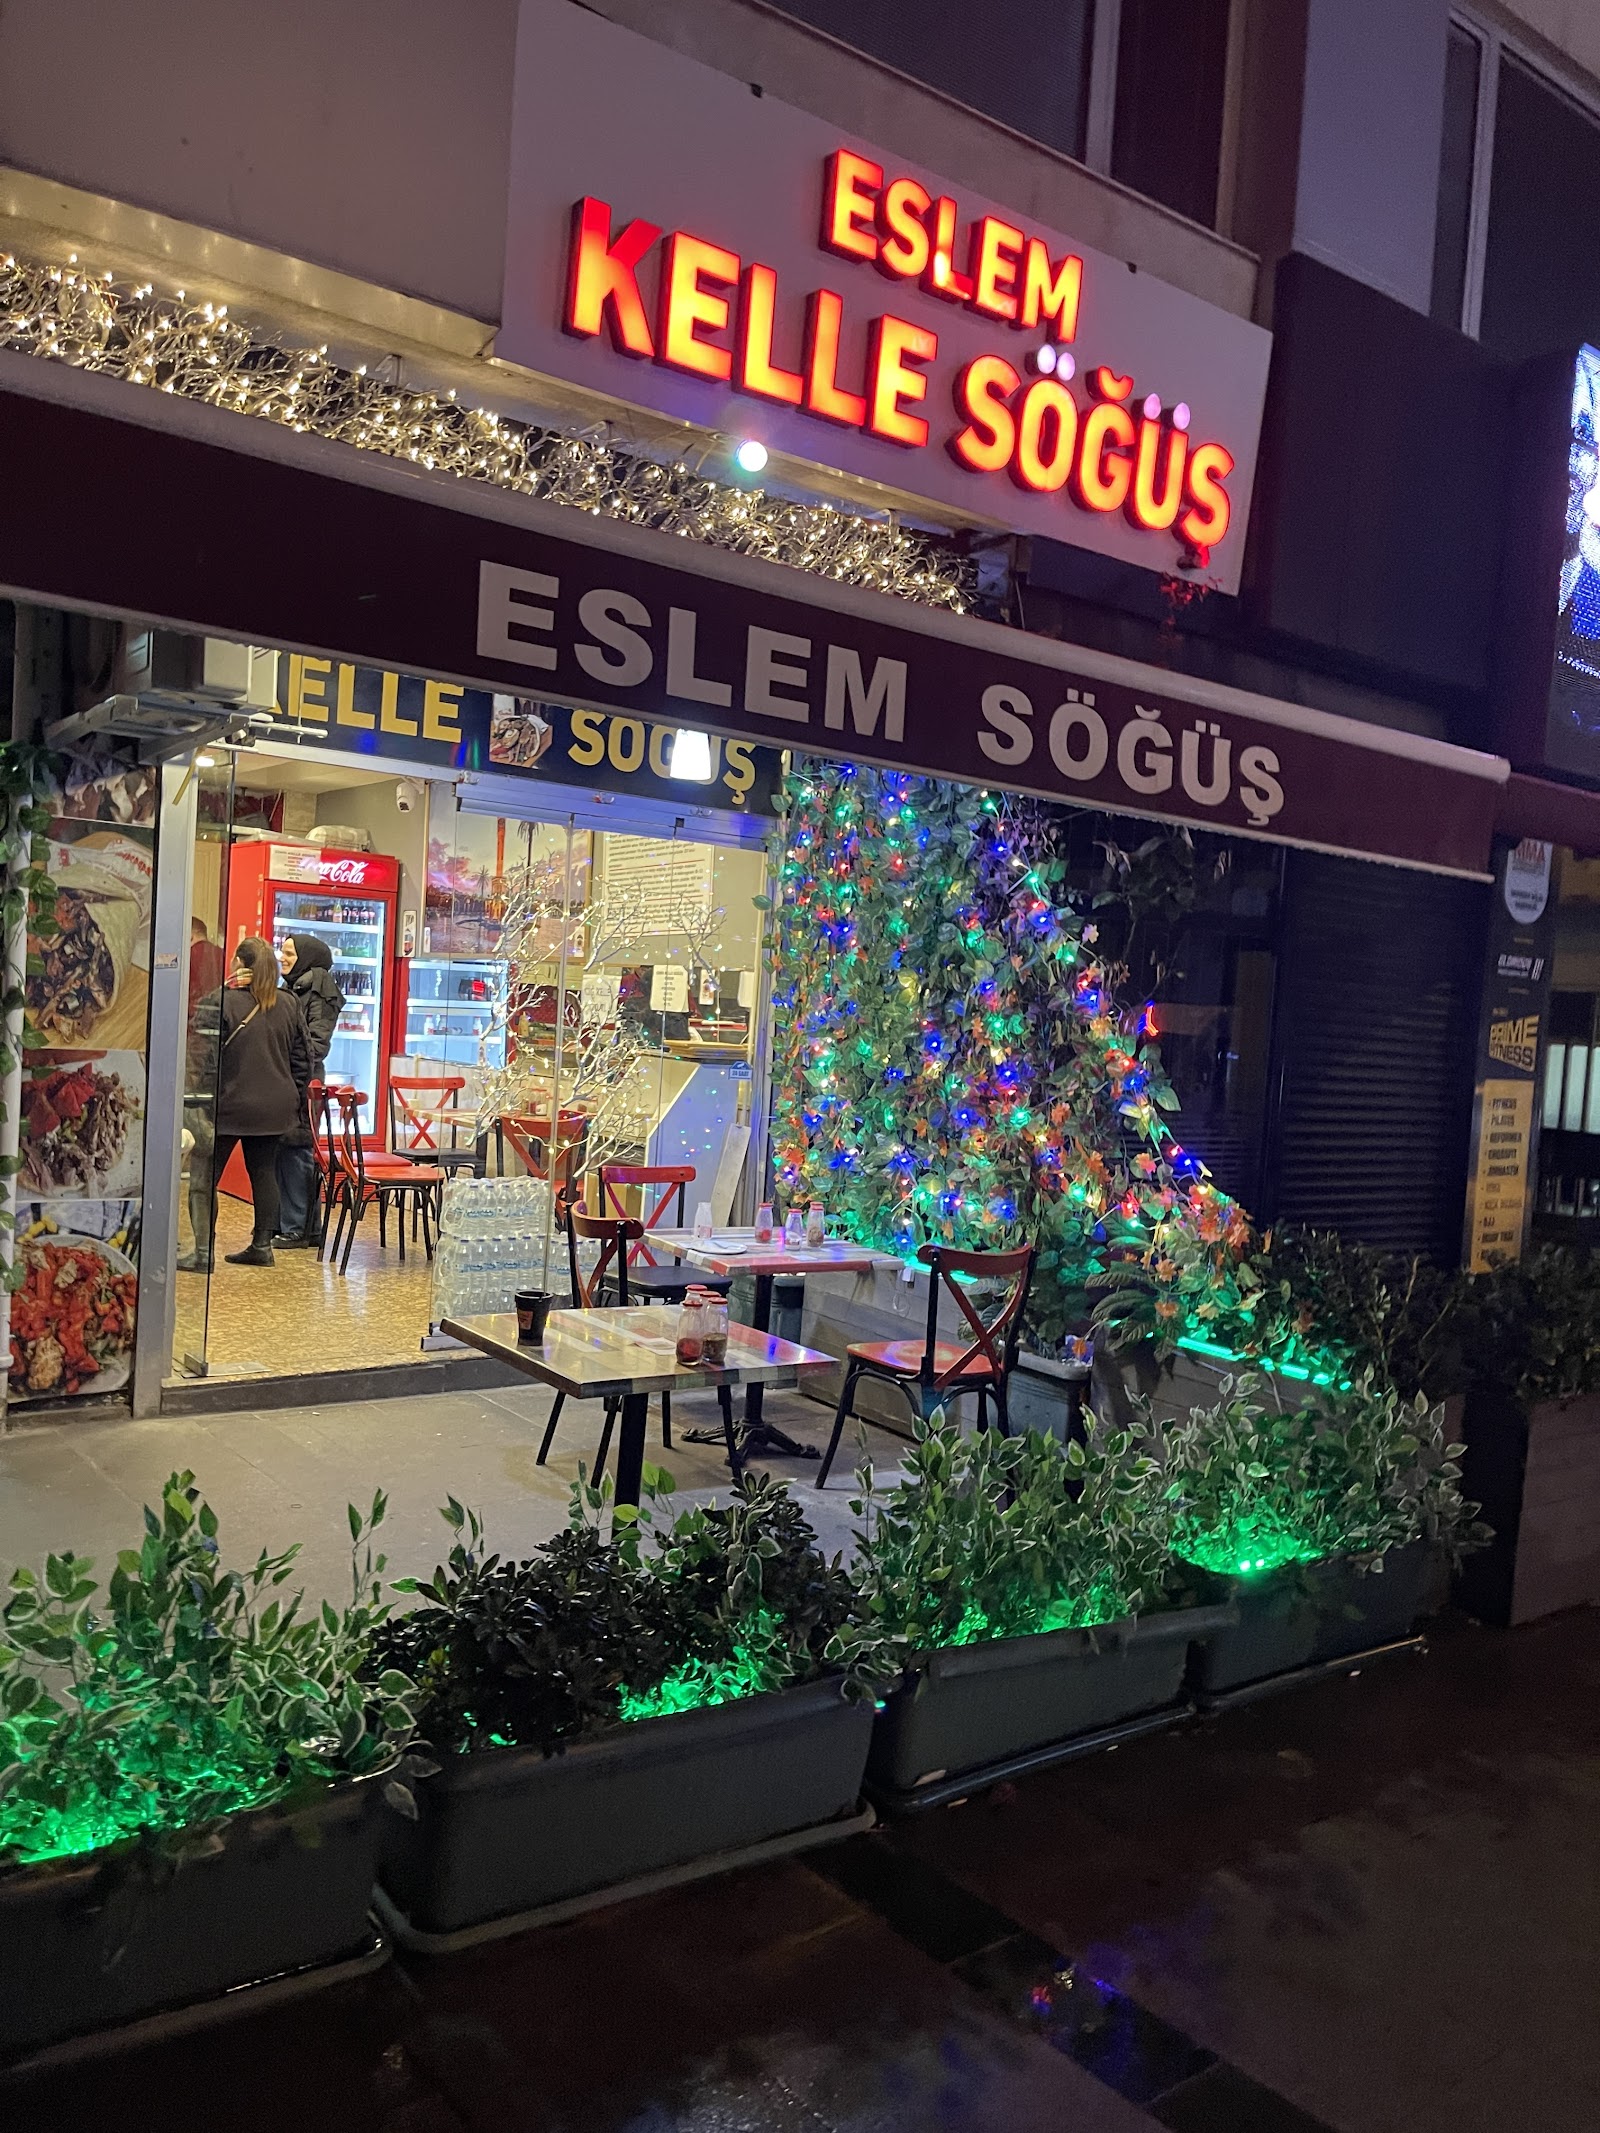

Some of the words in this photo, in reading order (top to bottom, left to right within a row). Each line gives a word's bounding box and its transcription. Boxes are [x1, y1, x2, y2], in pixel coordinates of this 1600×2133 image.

[822, 148, 1084, 343] ESLEM
[565, 196, 938, 449] KELLE
[950, 343, 1233, 569] SÖĞÜŞ
[270, 652, 465, 744] ELLE
[475, 559, 908, 742] ESLEM
[976, 683, 1285, 827] SÖĞÜŞ
[1490, 1015, 1540, 1045] PRIME
